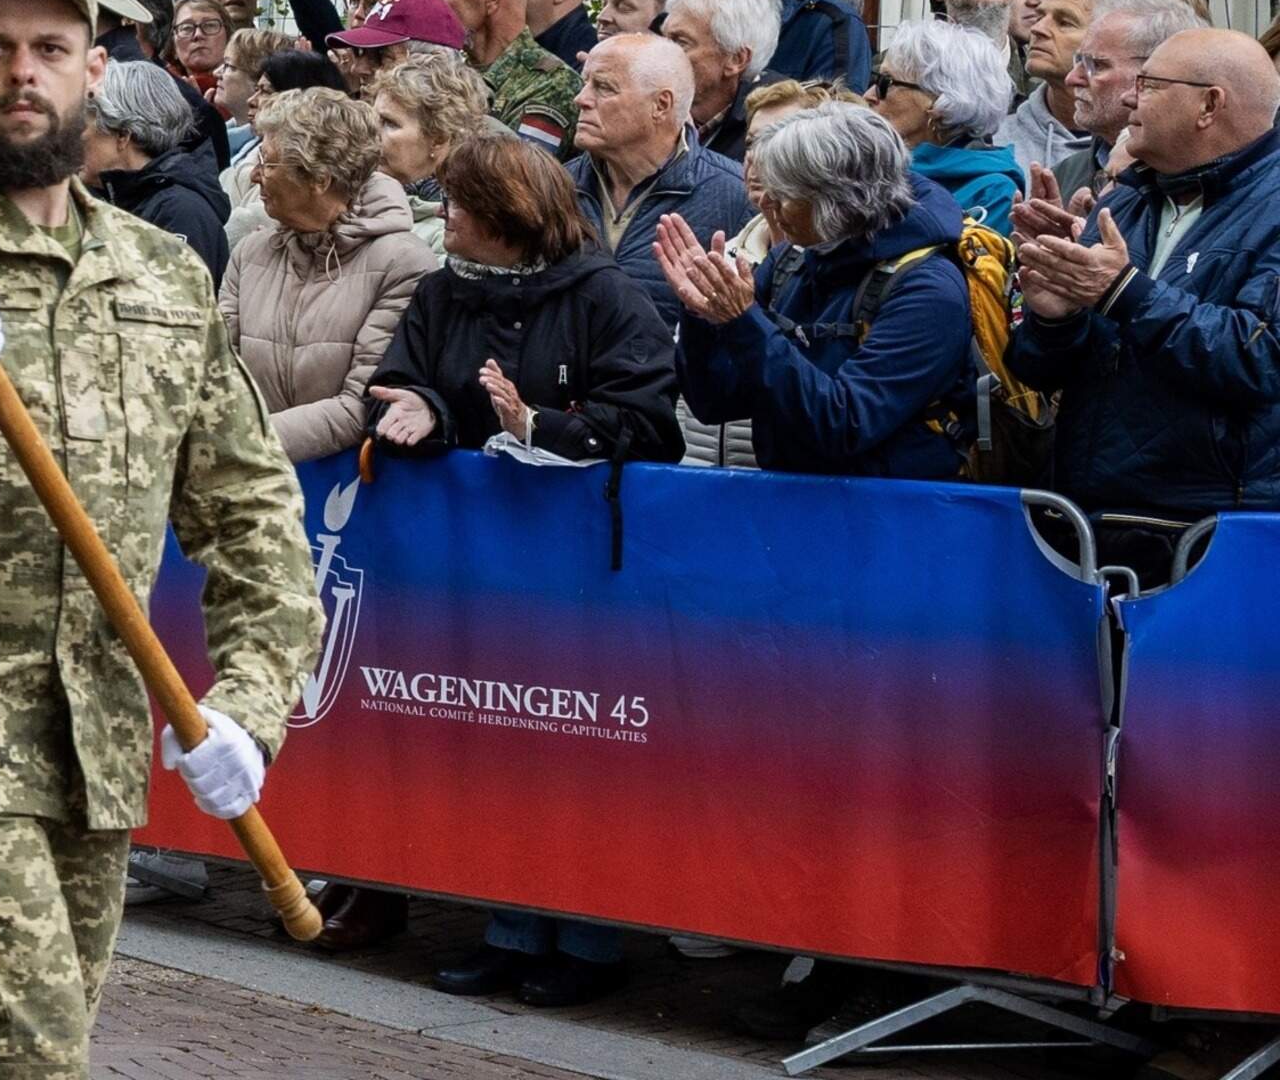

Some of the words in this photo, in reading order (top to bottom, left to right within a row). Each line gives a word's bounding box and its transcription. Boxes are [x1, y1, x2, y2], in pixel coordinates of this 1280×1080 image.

[359, 666, 601, 723] WAGENINGEN
[609, 694, 650, 728] 45
[360, 698, 427, 717] NATIONAAL
[429, 706, 476, 723] COMITÉ
[478, 713, 559, 734] HERDENKING
[561, 723, 649, 744] CAPITULATIES
